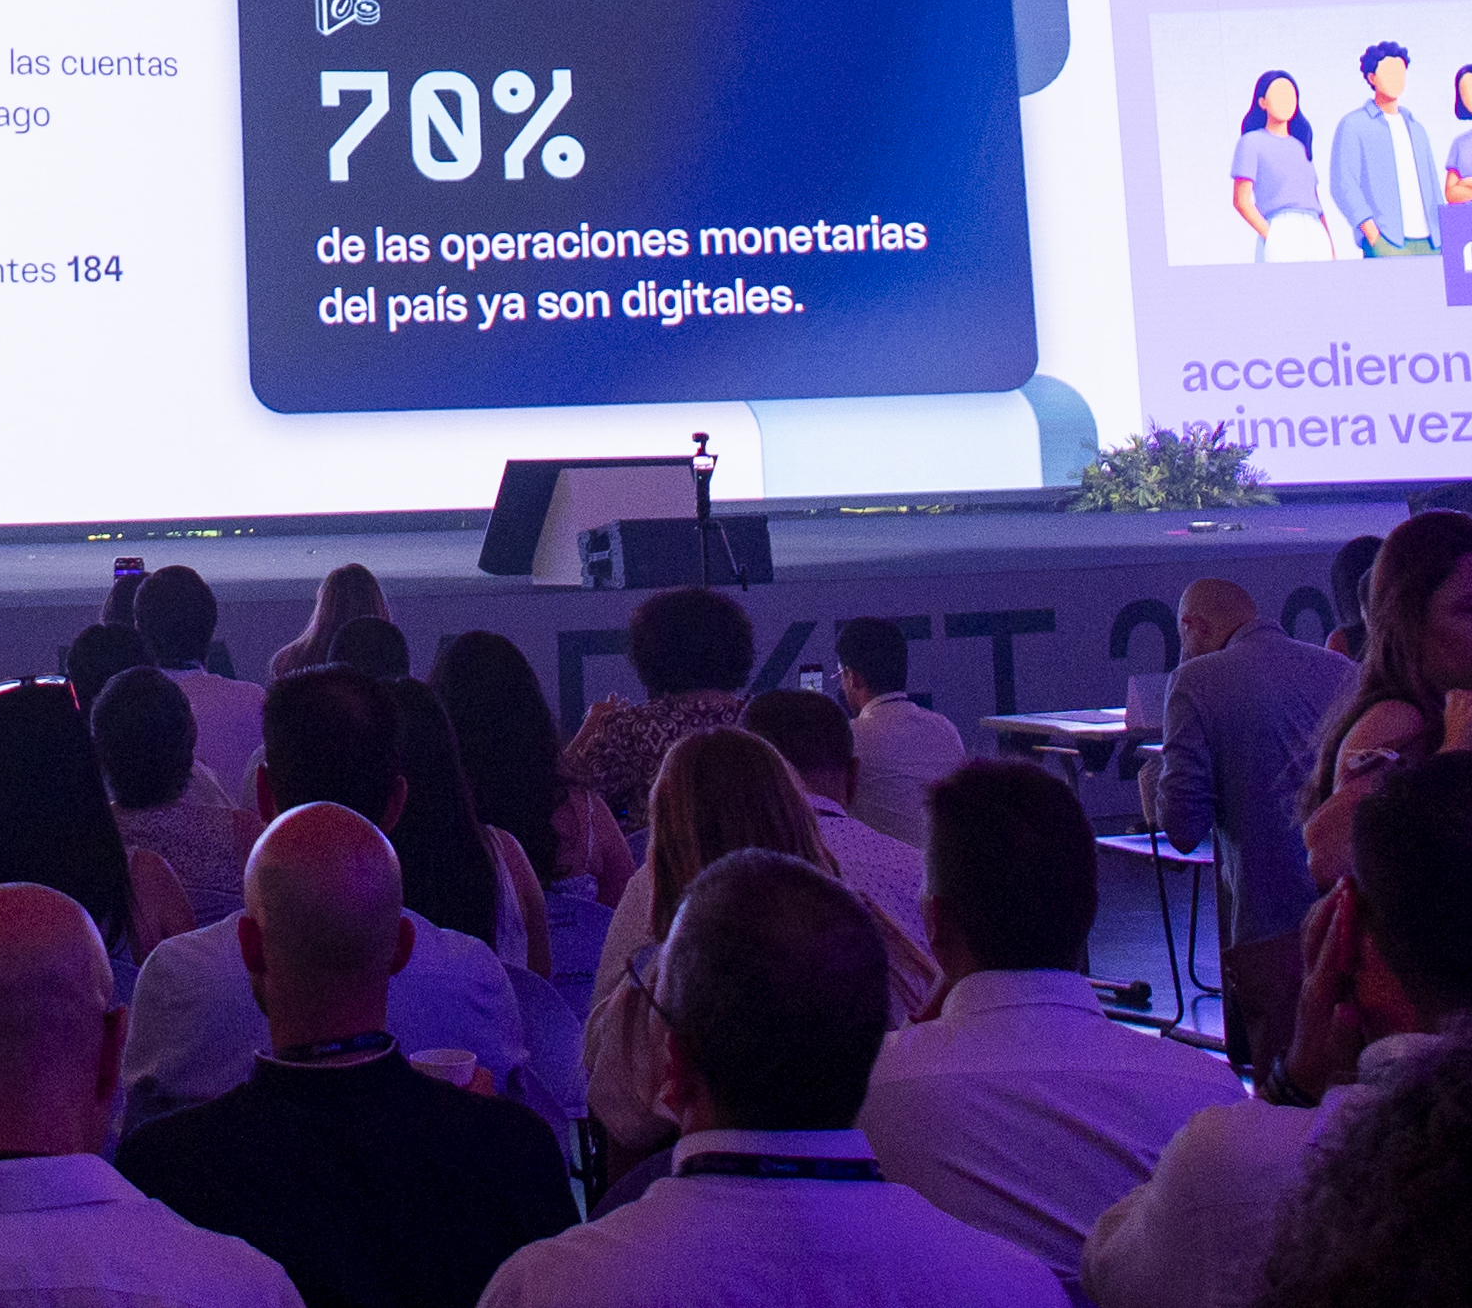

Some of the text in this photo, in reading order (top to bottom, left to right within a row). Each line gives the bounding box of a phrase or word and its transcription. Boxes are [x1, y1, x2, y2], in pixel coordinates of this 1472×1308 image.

[10, 48, 50, 75] las
[61, 53, 178, 77] cuentas
[320, 69, 585, 182] 70%
[67, 255, 123, 282] 184
[317, 215, 927, 271] de las operaciones monetarias
[319, 278, 804, 332] del país ya son digitales.
[1183, 342, 1472, 392] accedieron
